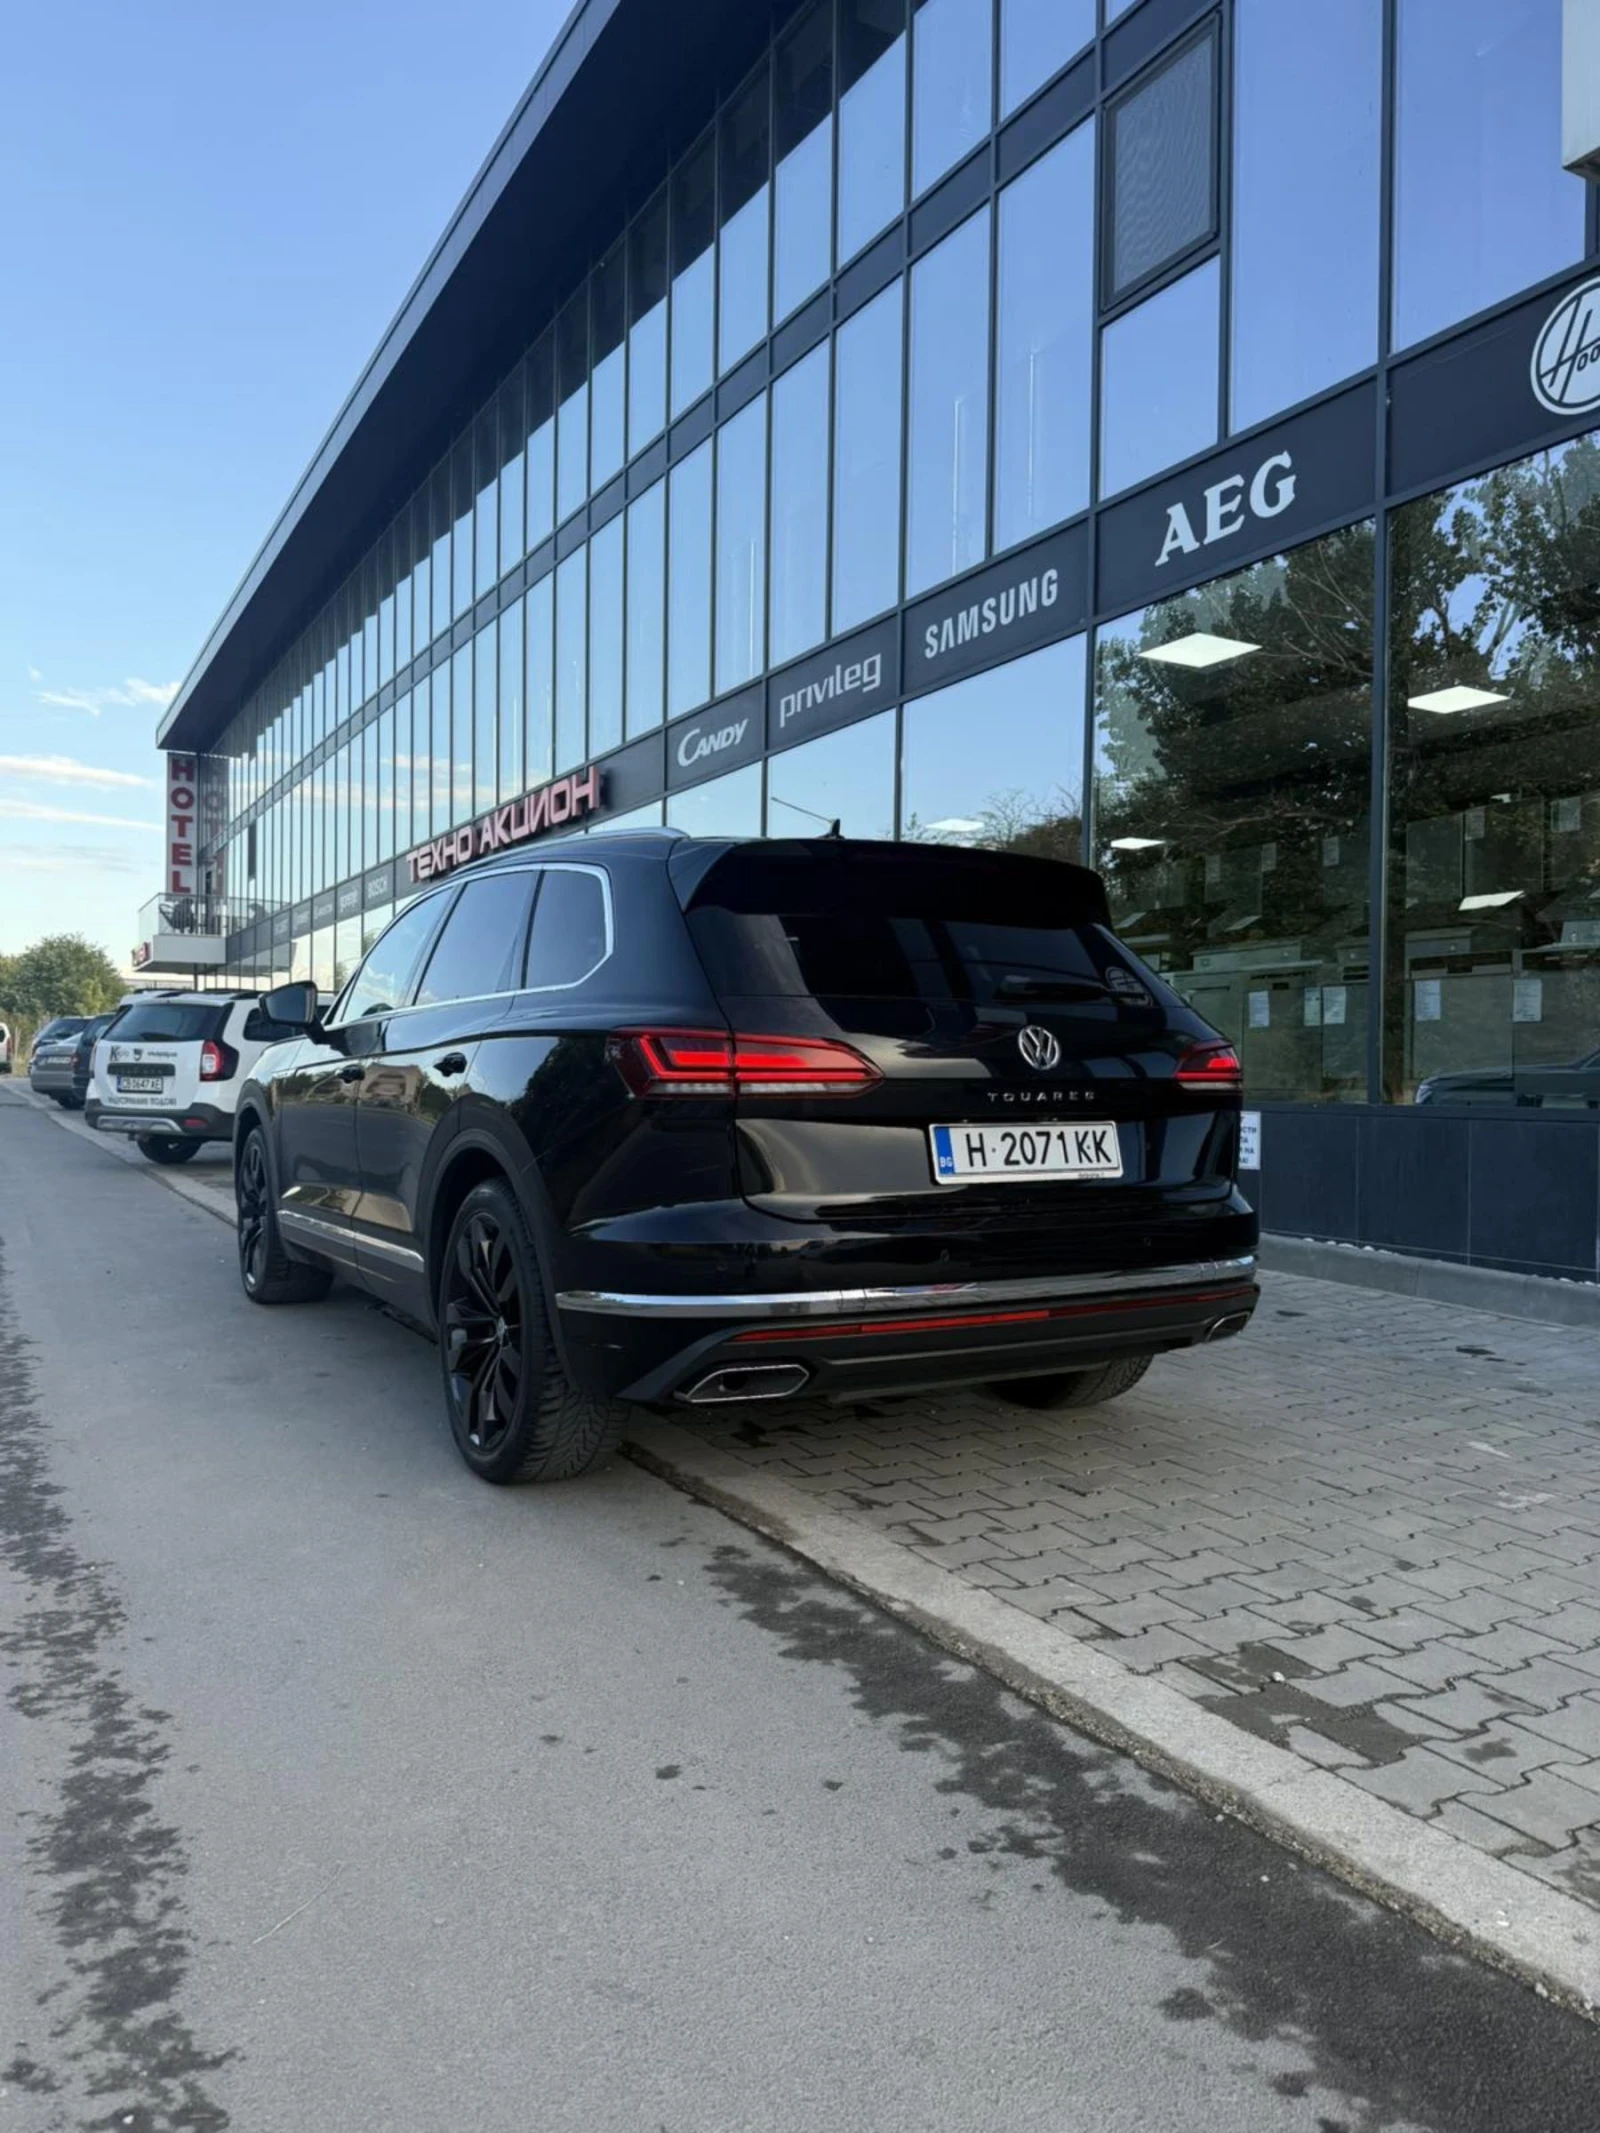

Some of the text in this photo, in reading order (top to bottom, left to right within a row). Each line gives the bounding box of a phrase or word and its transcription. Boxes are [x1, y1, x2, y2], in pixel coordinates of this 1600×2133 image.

[1155, 451, 1297, 567] AEG
[924, 568, 1058, 660] SAMSUNG
[779, 653, 881, 727] privileg
[171, 758, 194, 893] HOTEL
[406, 765, 600, 883] ТЕХНО АКЦИОН
[939, 1157, 953, 1168] BG
